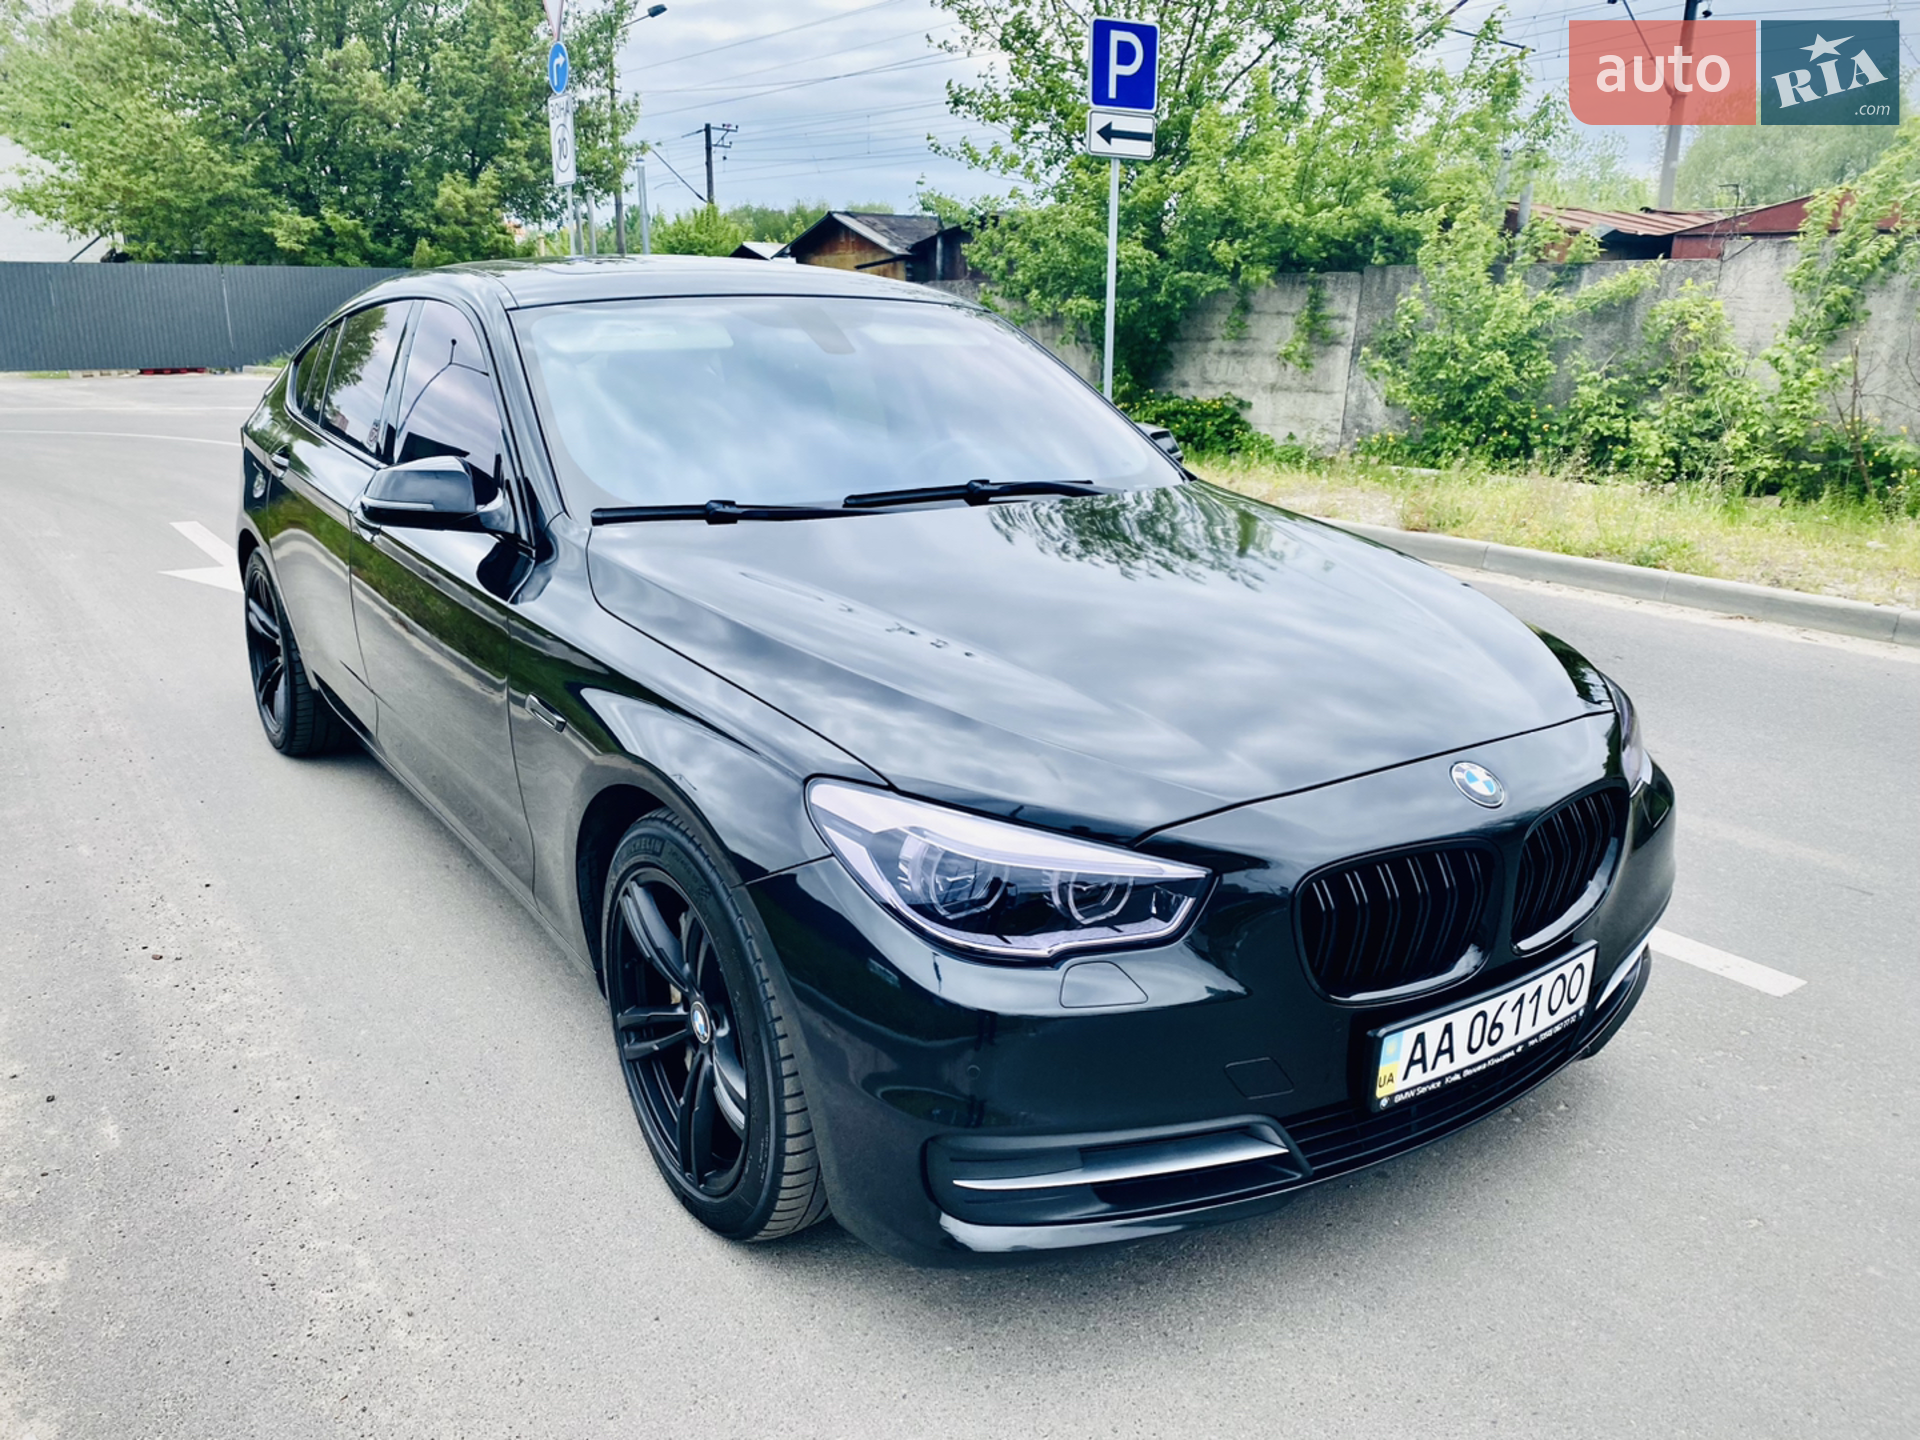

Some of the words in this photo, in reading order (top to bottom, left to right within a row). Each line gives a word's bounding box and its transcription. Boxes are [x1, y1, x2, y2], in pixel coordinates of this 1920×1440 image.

[1108, 29, 1144, 99] P
[550, 100, 571, 120] ЗОНА
[557, 137, 569, 161] 10
[1402, 1021, 1455, 1082] AA
[1467, 984, 1543, 1055] 0611
[1378, 1072, 1395, 1088] UA
[1394, 1089, 1417, 1103] BMW
[1416, 1080, 1442, 1096] Service
